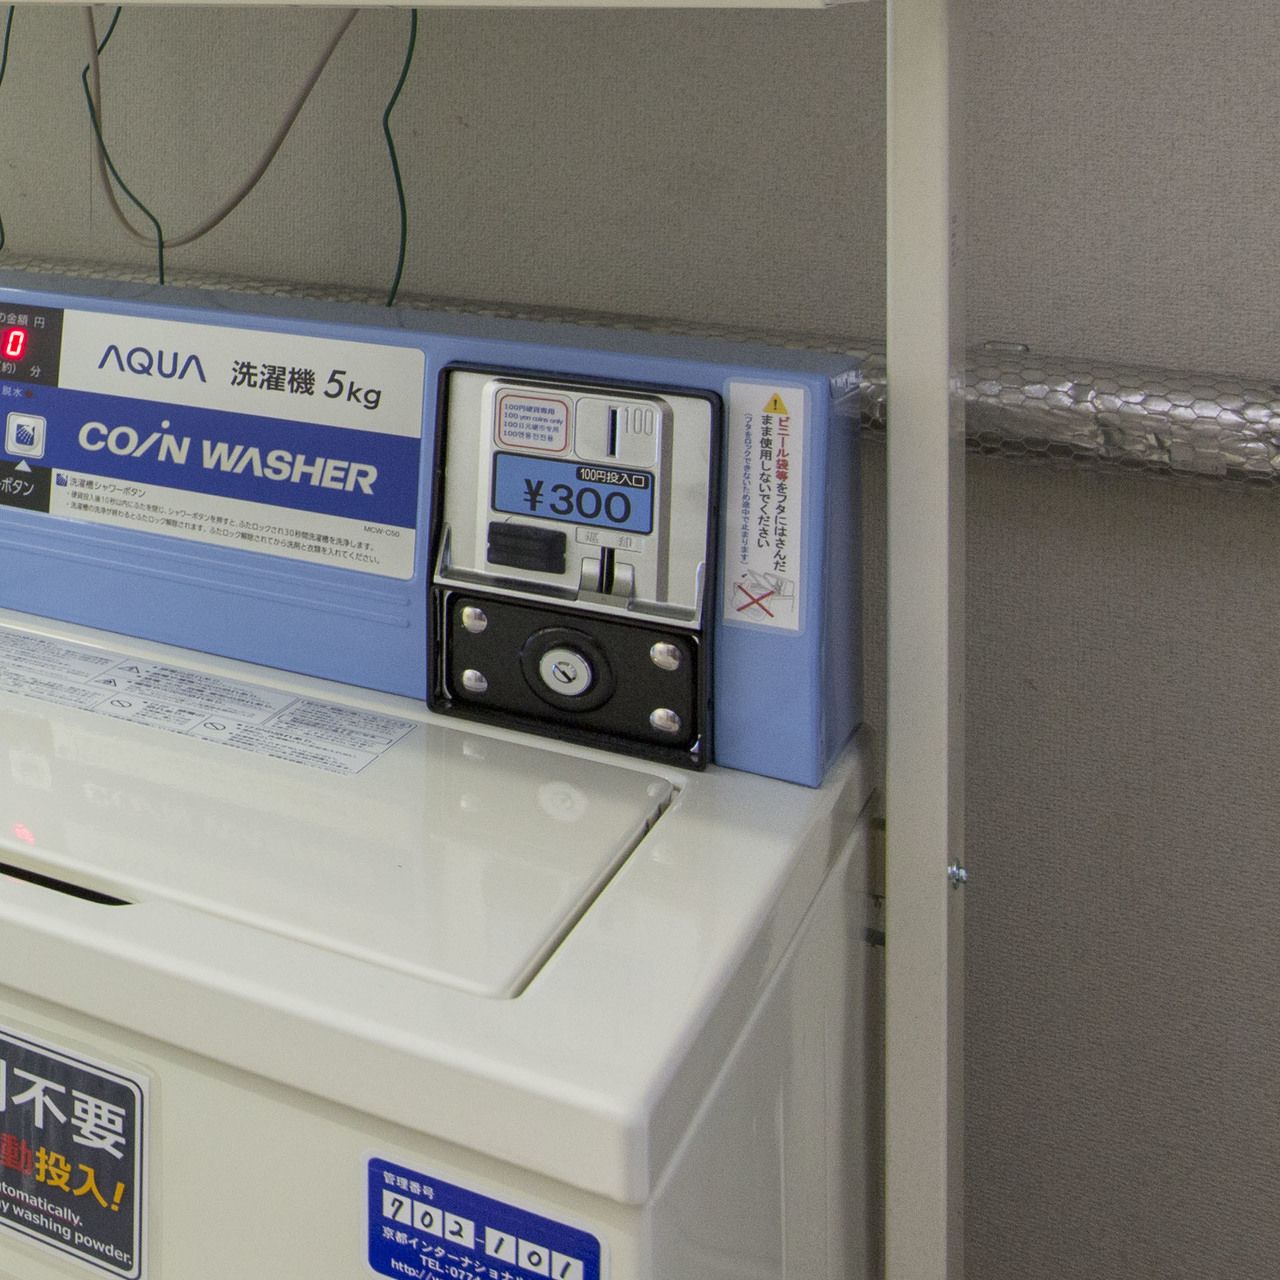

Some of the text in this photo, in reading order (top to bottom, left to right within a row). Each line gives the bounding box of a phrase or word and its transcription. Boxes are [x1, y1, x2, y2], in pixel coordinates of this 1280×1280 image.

[34, 317, 45, 328] 円
[6, 330, 25, 356] 0
[30, 366, 41, 377] 分
[98, 344, 383, 410] AQUA 洗濯機 5kg
[1, 385, 23, 398] 脱水
[624, 406, 654, 436] 100
[78, 418, 379, 496] COIN WASHER
[70, 477, 146, 498] 洗濯槽シャワーボタン
[580, 468, 645, 489] 100円投入口
[757, 415, 773, 549] まま使用しないでください
[523, 478, 632, 524] ¥300
[773, 417, 791, 573] ビニール袋等をフタにはさんだ
[363, 524, 400, 538] MCW-C50
[383, 1171, 435, 1200] 管理番号
[12, 1203, 71, 1240] washing
[74, 1229, 132, 1266] powder.
[390, 1197, 572, 1280] 702-101
